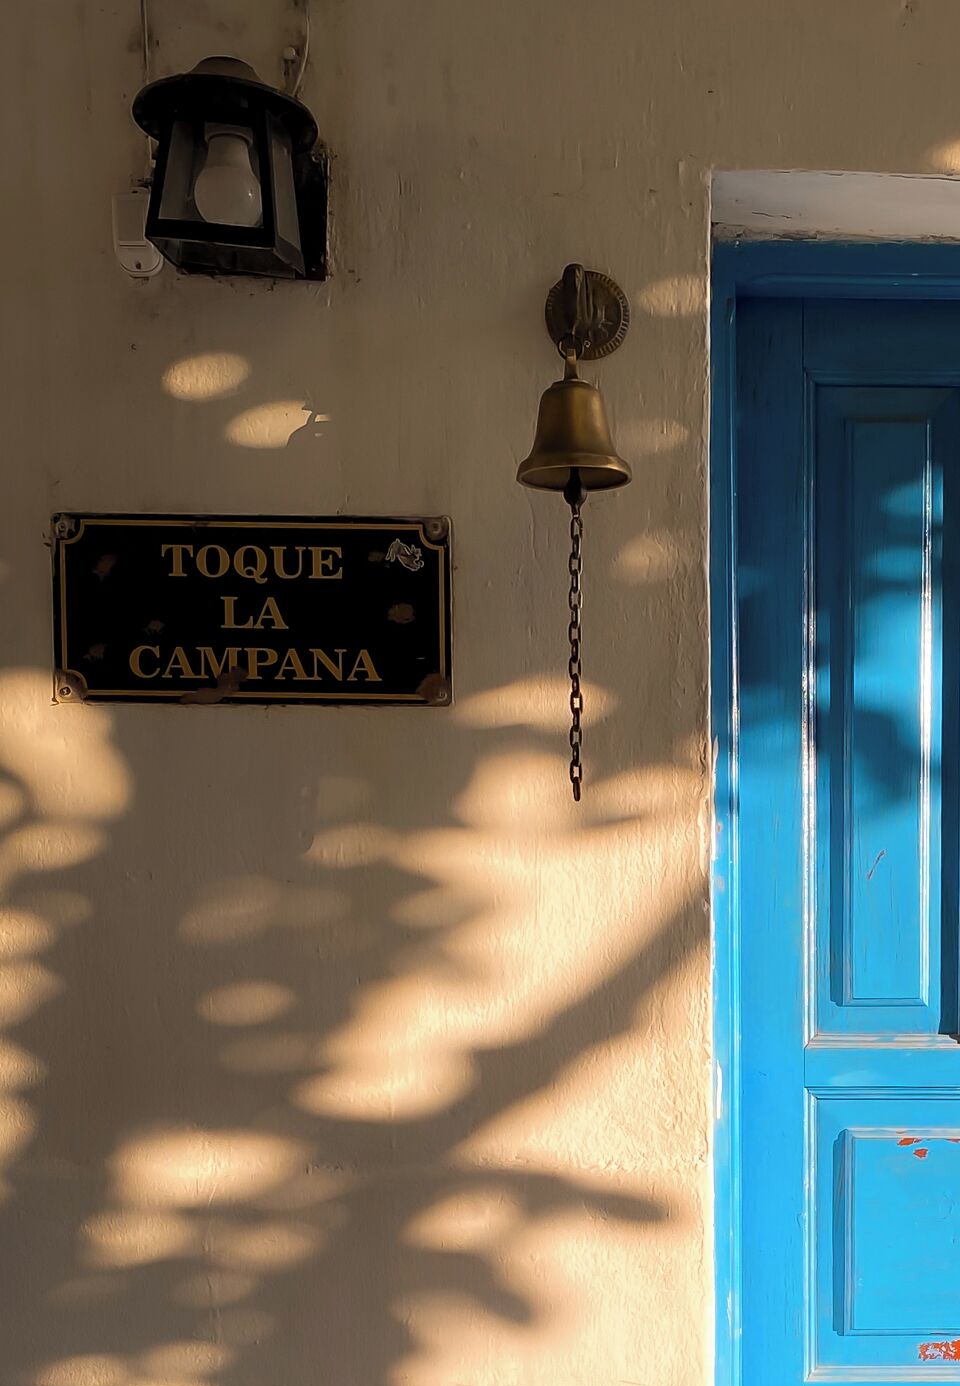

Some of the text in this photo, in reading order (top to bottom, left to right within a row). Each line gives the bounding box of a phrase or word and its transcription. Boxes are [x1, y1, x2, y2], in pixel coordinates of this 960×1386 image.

[161, 544, 343, 584] TOQUE
[220, 596, 289, 629] LA
[128, 645, 383, 682] CAMPANA
